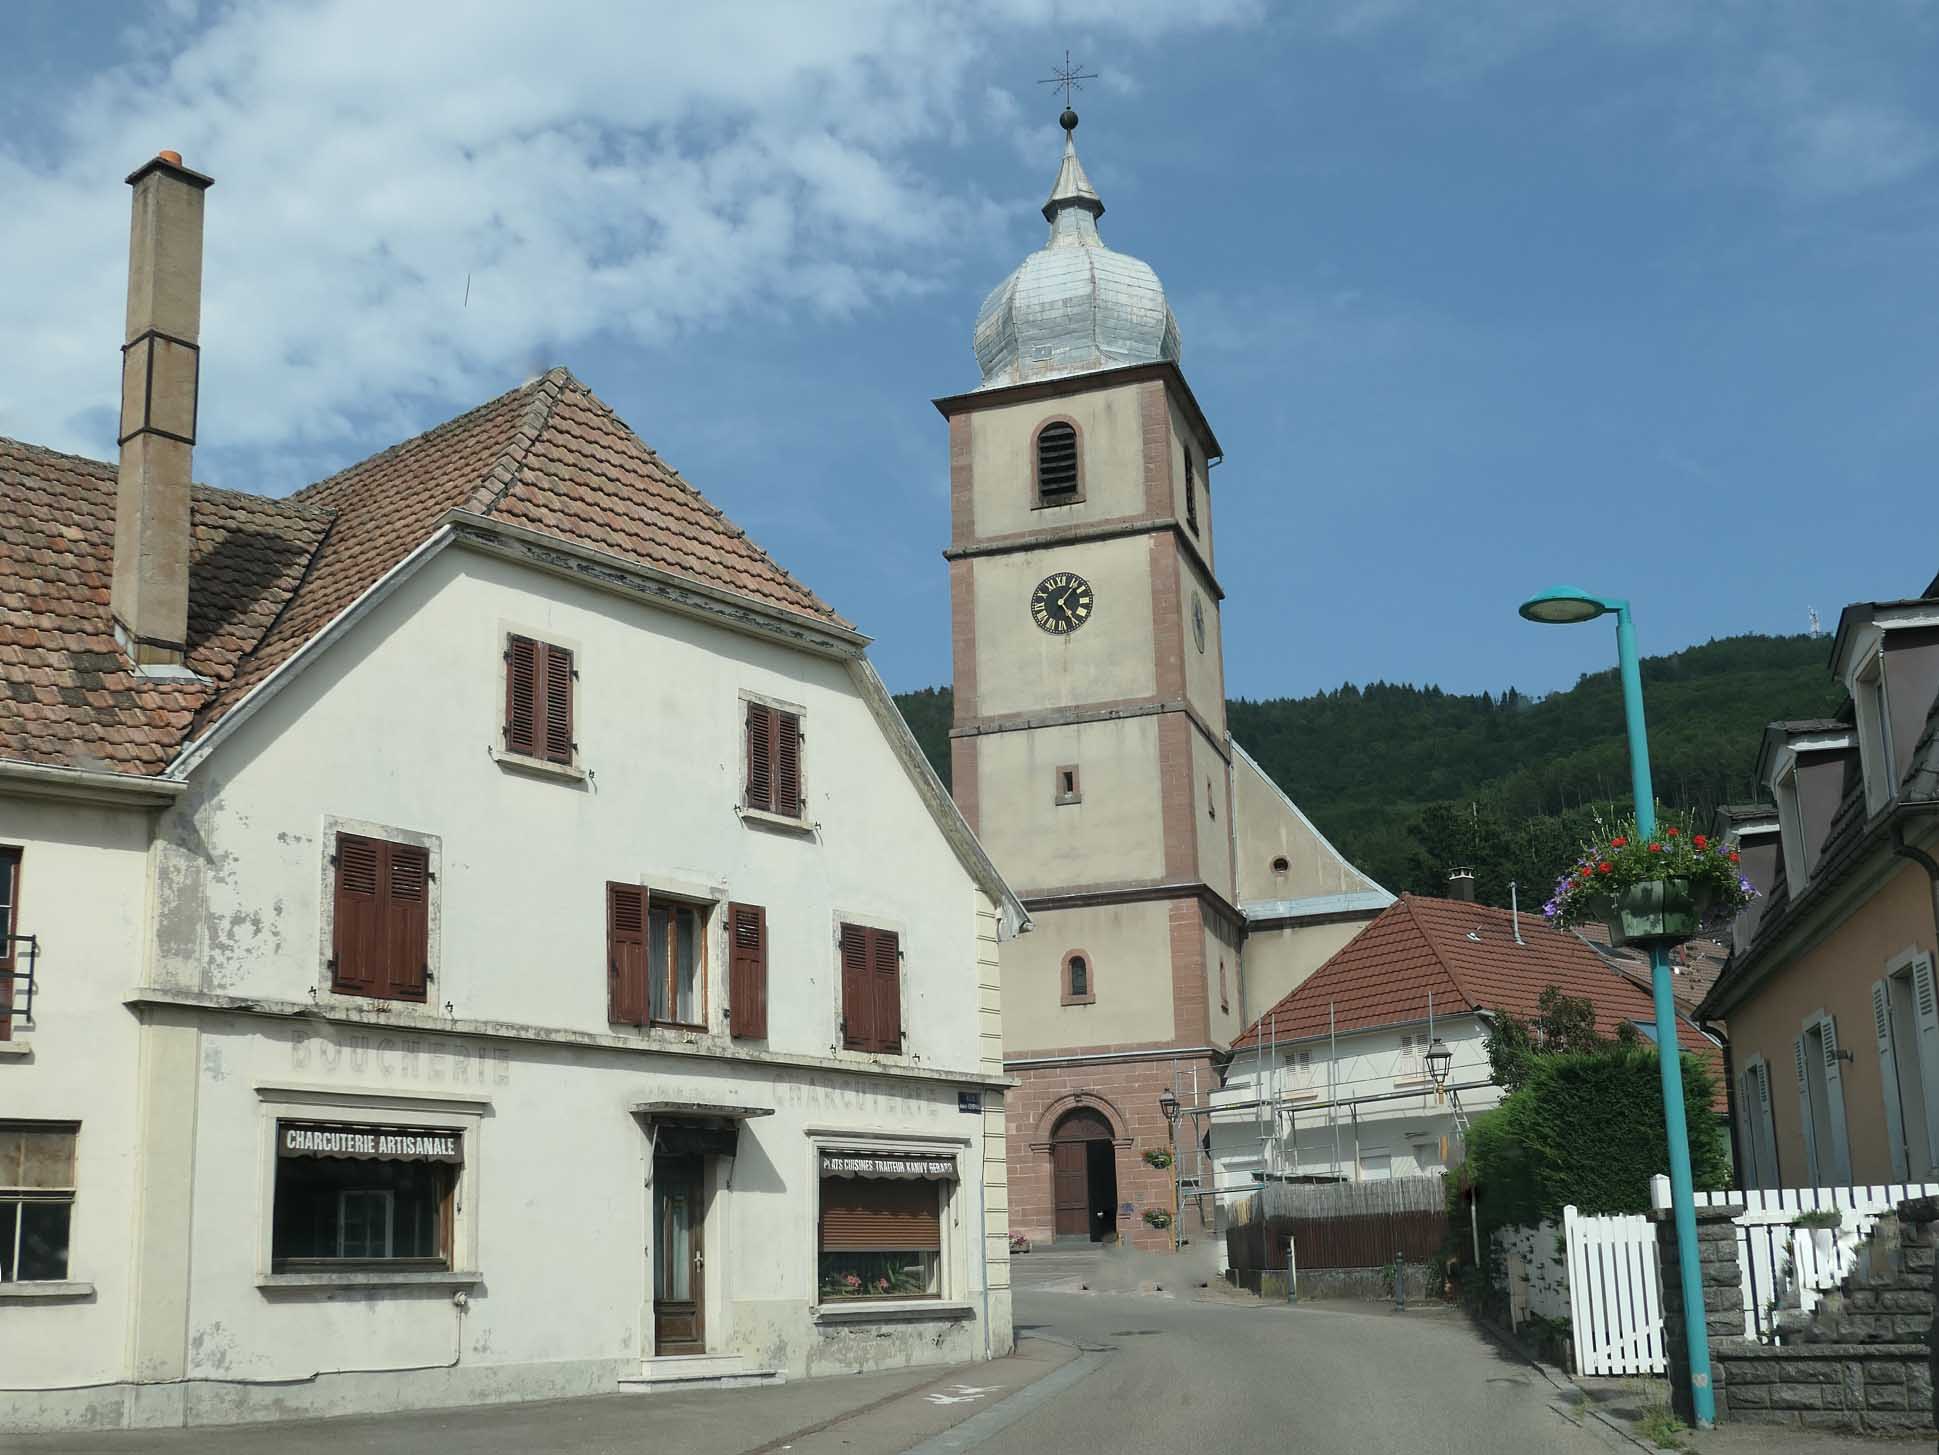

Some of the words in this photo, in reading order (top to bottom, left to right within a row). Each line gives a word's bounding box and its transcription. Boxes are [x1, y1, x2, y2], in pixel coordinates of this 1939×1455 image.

[292, 1030, 510, 1086] BOUCHERIE
[286, 1130, 375, 1153] CHARCUTERIE
[378, 1136, 456, 1155] ARTISANALE
[844, 1159, 873, 1172] CUISINES
[875, 1160, 905, 1173] TRAITEUR
